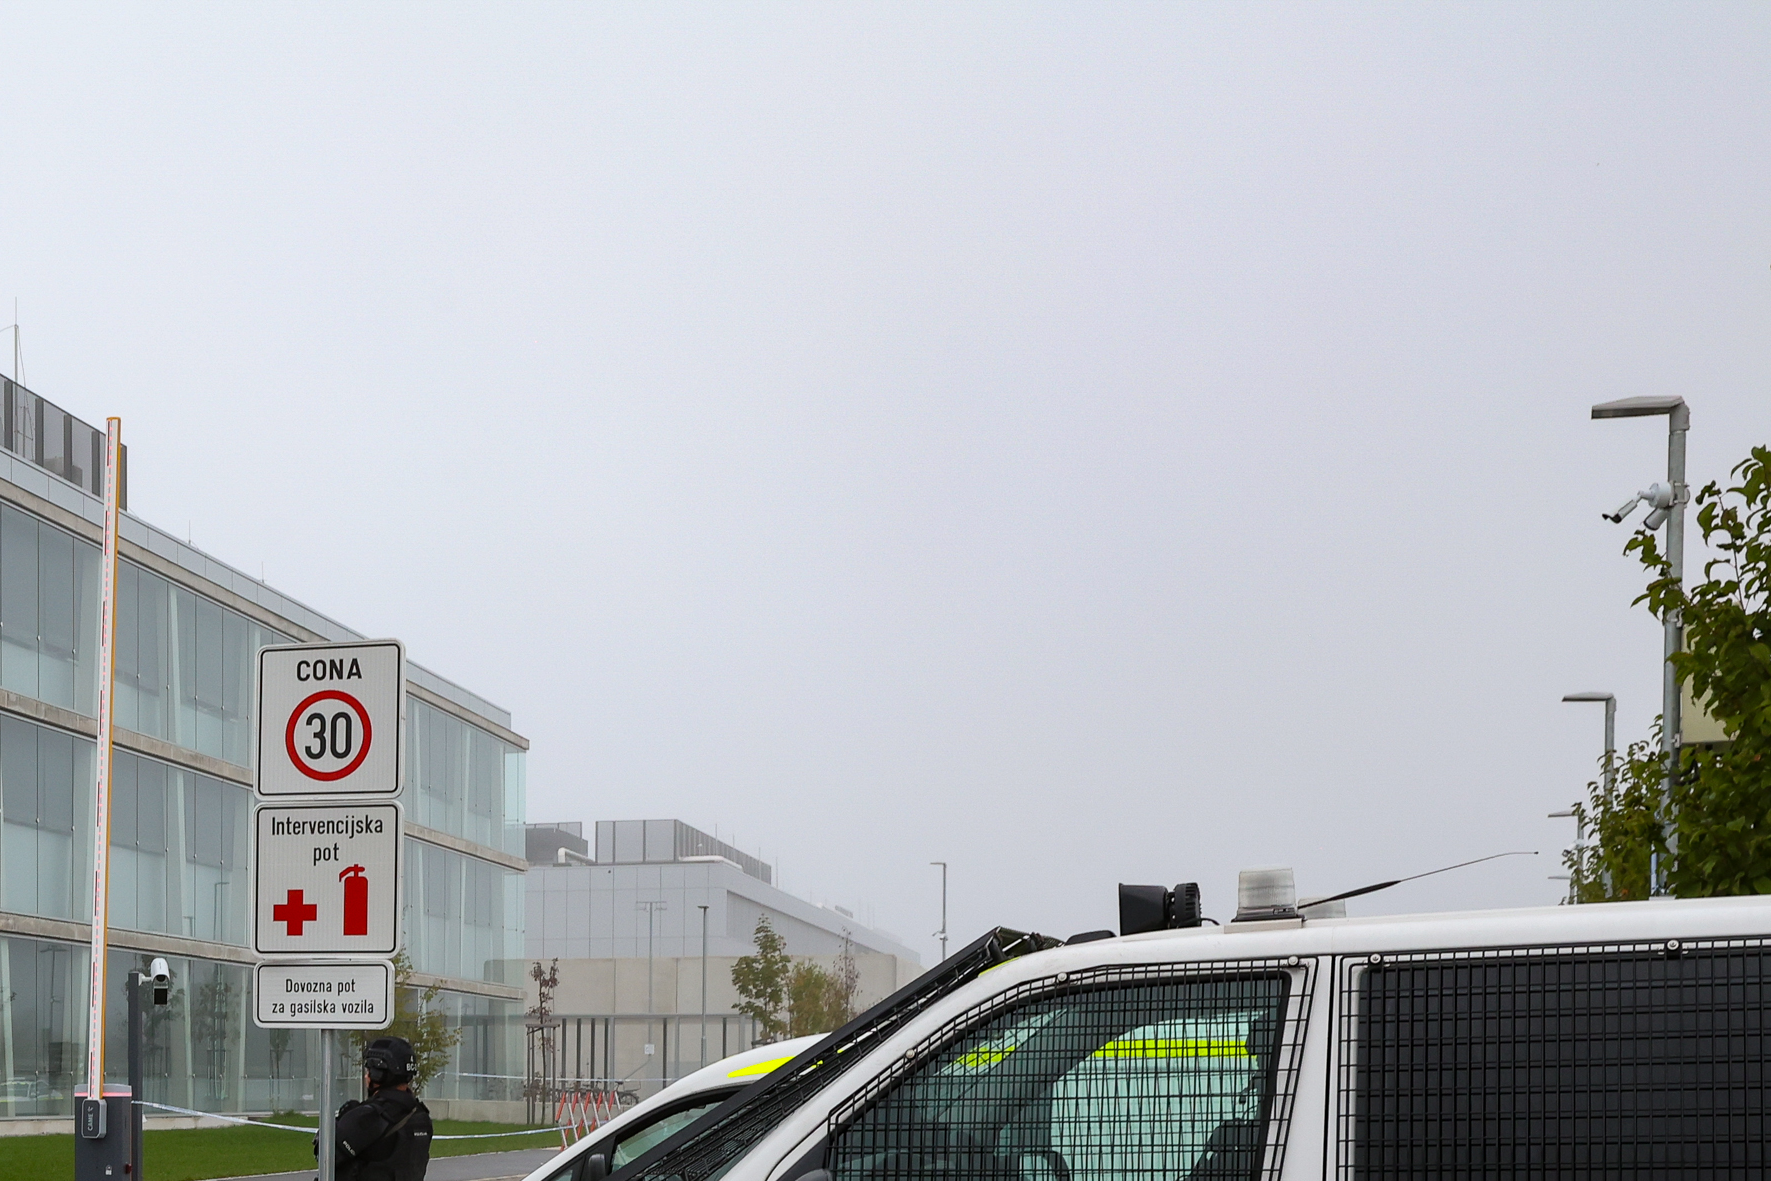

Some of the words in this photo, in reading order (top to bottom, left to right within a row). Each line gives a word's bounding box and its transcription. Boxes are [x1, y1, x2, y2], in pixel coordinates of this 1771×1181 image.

[296, 658, 363, 682] CONA
[304, 711, 353, 760] 30
[271, 814, 383, 839] Intervencijska
[313, 843, 340, 867] pot
[285, 978, 332, 993] Dovozna
[338, 977, 356, 996] pot
[272, 1003, 285, 1014] za
[291, 1000, 336, 1017] gasilska
[342, 999, 374, 1014] vozila
